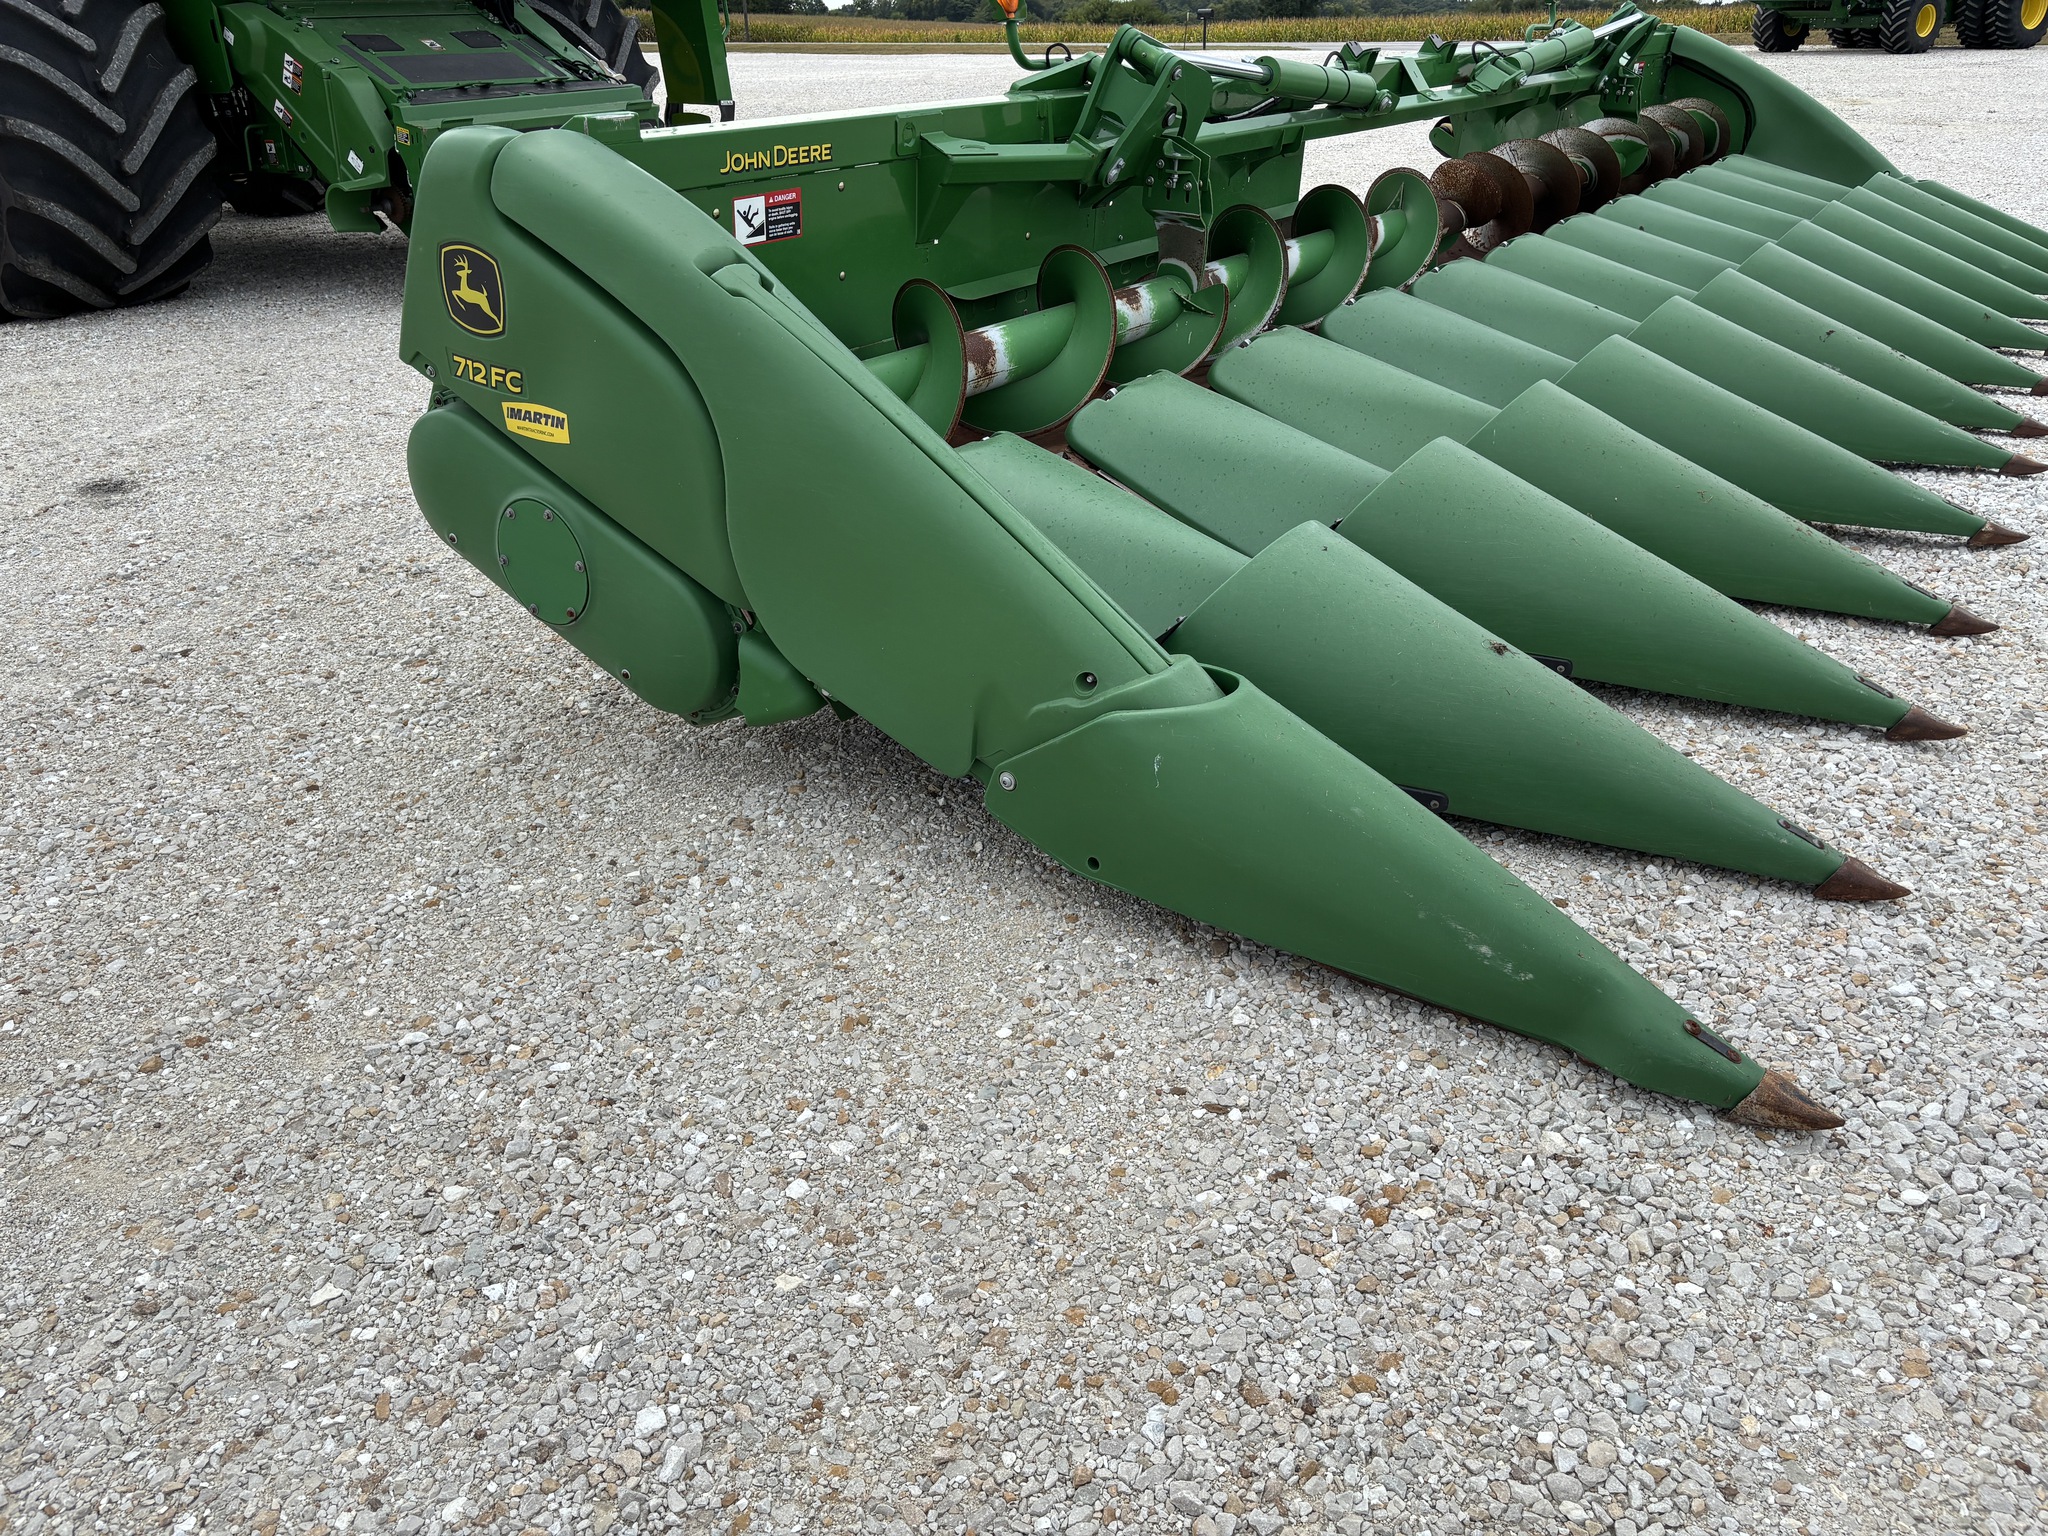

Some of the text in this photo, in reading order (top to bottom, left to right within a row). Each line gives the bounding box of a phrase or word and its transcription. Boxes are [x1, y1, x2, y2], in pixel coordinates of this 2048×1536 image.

[720, 143, 832, 174] JOHN DEERE
[774, 192, 797, 202] DANGER
[453, 354, 522, 394] 712 FC
[509, 407, 565, 430] MARTIN
